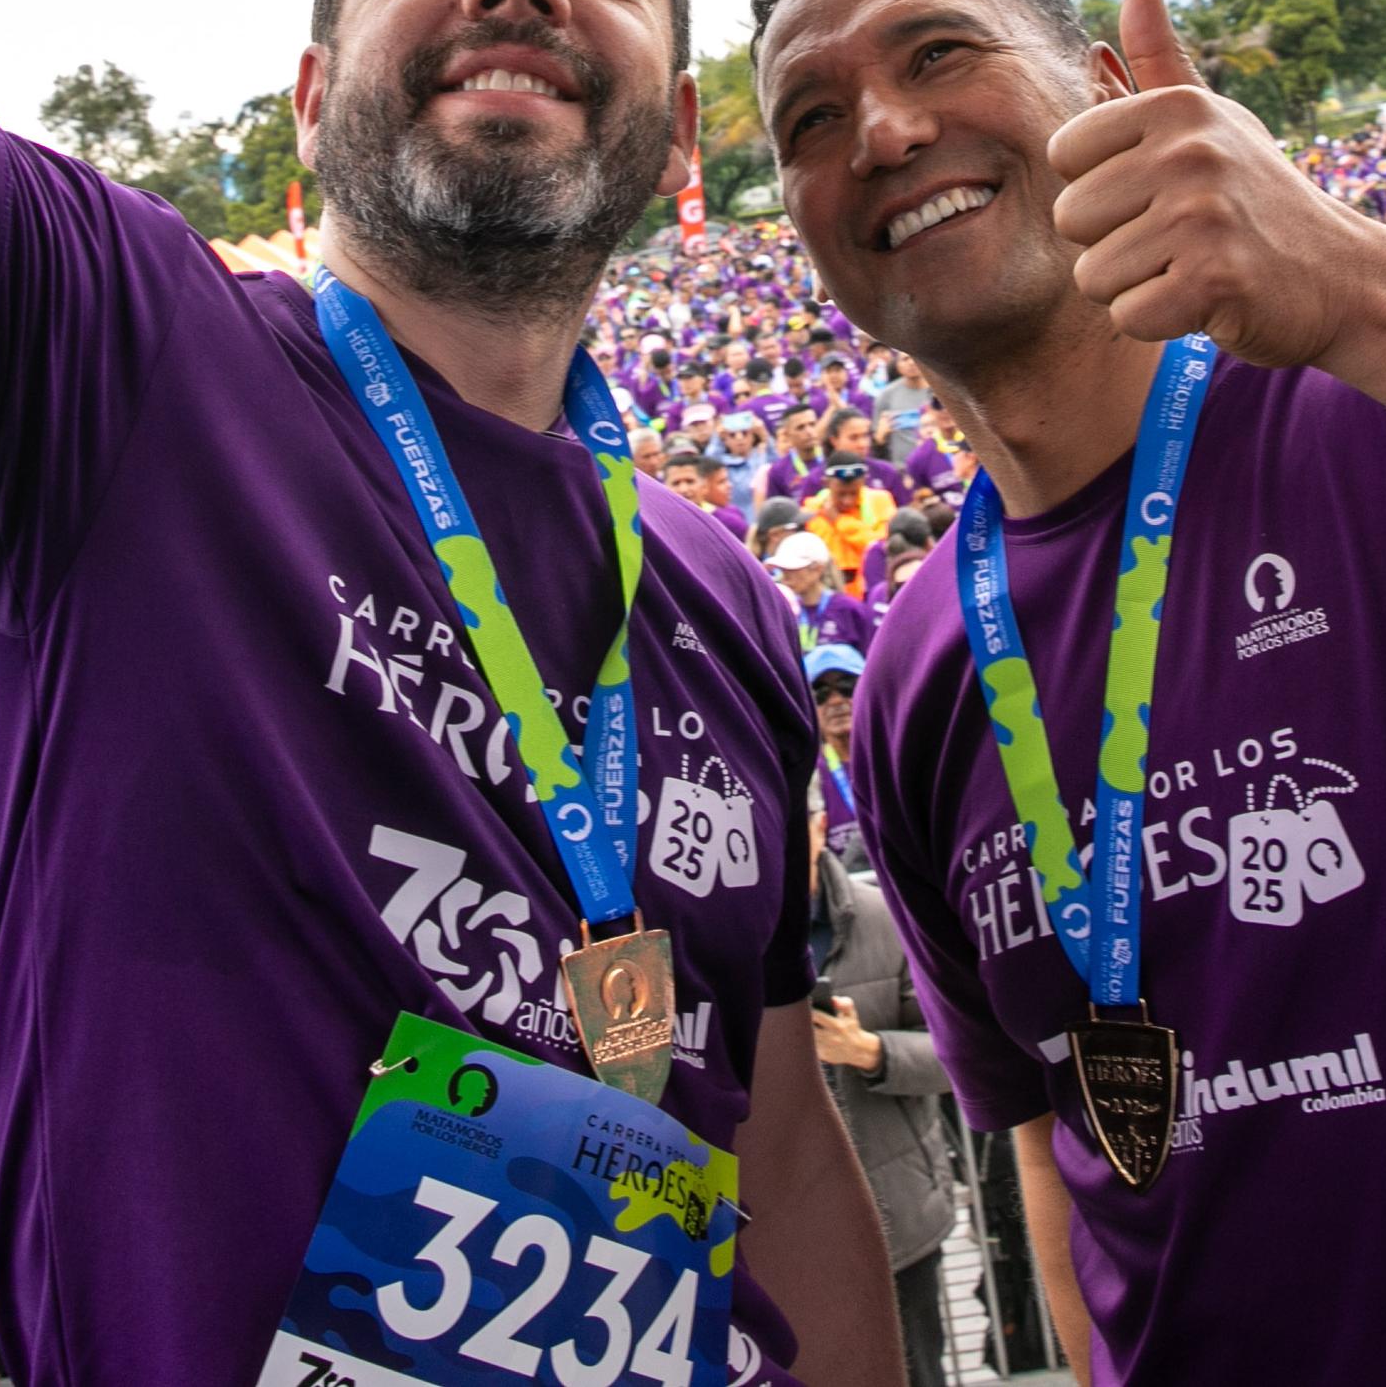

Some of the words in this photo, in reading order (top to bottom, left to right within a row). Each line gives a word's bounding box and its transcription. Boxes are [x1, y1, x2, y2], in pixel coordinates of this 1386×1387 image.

[680, 199, 705, 224] G
[386, 412, 452, 530] FUERZAS
[973, 558, 1003, 655] FUERZAS
[1235, 607, 1327, 649] MATAMOROS
[1236, 644, 1261, 661] POR
[1259, 635, 1284, 652] LOS
[652, 706, 705, 741] LO
[605, 693, 626, 826] FUERZAS
[1149, 761, 1199, 800] OR
[1213, 727, 1298, 778] LOS
[671, 799, 712, 845] 20
[663, 835, 704, 880] 25
[1113, 799, 1134, 925] FUERZAS
[1240, 835, 1287, 873] 20
[1242, 876, 1285, 914] 25
[1182, 1033, 1382, 1117] indumil
[414, 1108, 503, 1149] MATAMOROS
[435, 1130, 457, 1144] LOS
[587, 1114, 662, 1155] CARRERA
[571, 1134, 687, 1211] HÉROES
[376, 1175, 699, 1387] 3234
